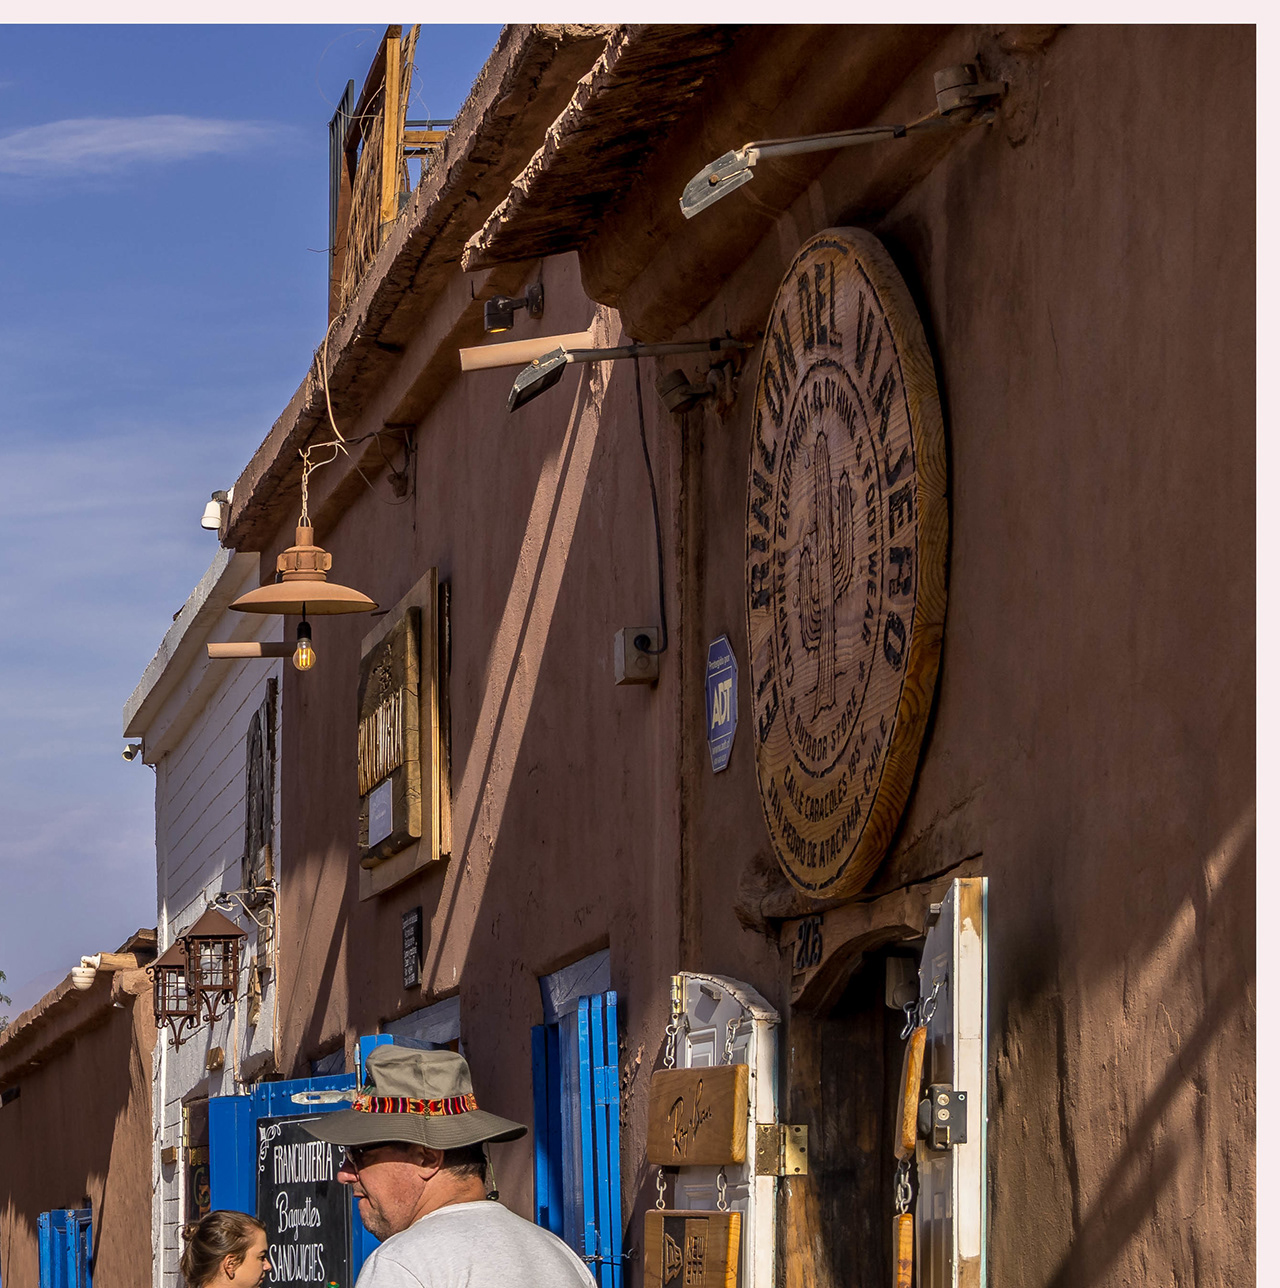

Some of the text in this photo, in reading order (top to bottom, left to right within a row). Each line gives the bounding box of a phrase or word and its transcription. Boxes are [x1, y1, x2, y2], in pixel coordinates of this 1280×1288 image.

[750, 261, 915, 744] EL RINCON DEL VIAJERO
[776, 548, 796, 688] CAMPING
[860, 462, 879, 647] FOOTWEAR
[709, 653, 731, 670] Protegido por
[712, 681, 733, 730] ADT
[794, 688, 859, 763] OUTDOOR STORE
[783, 764, 806, 817] CALLE
[804, 772, 848, 825] CARACOLES
[768, 777, 784, 828] SAN
[781, 820, 807, 868] PEDRO
[806, 839, 818, 869] DE
[796, 916, 825, 970] 205
[273, 1141, 334, 1184] FRANCHUTERIA
[275, 1190, 321, 1241] Baguettes
[268, 1243, 325, 1283] SANDWICHES
